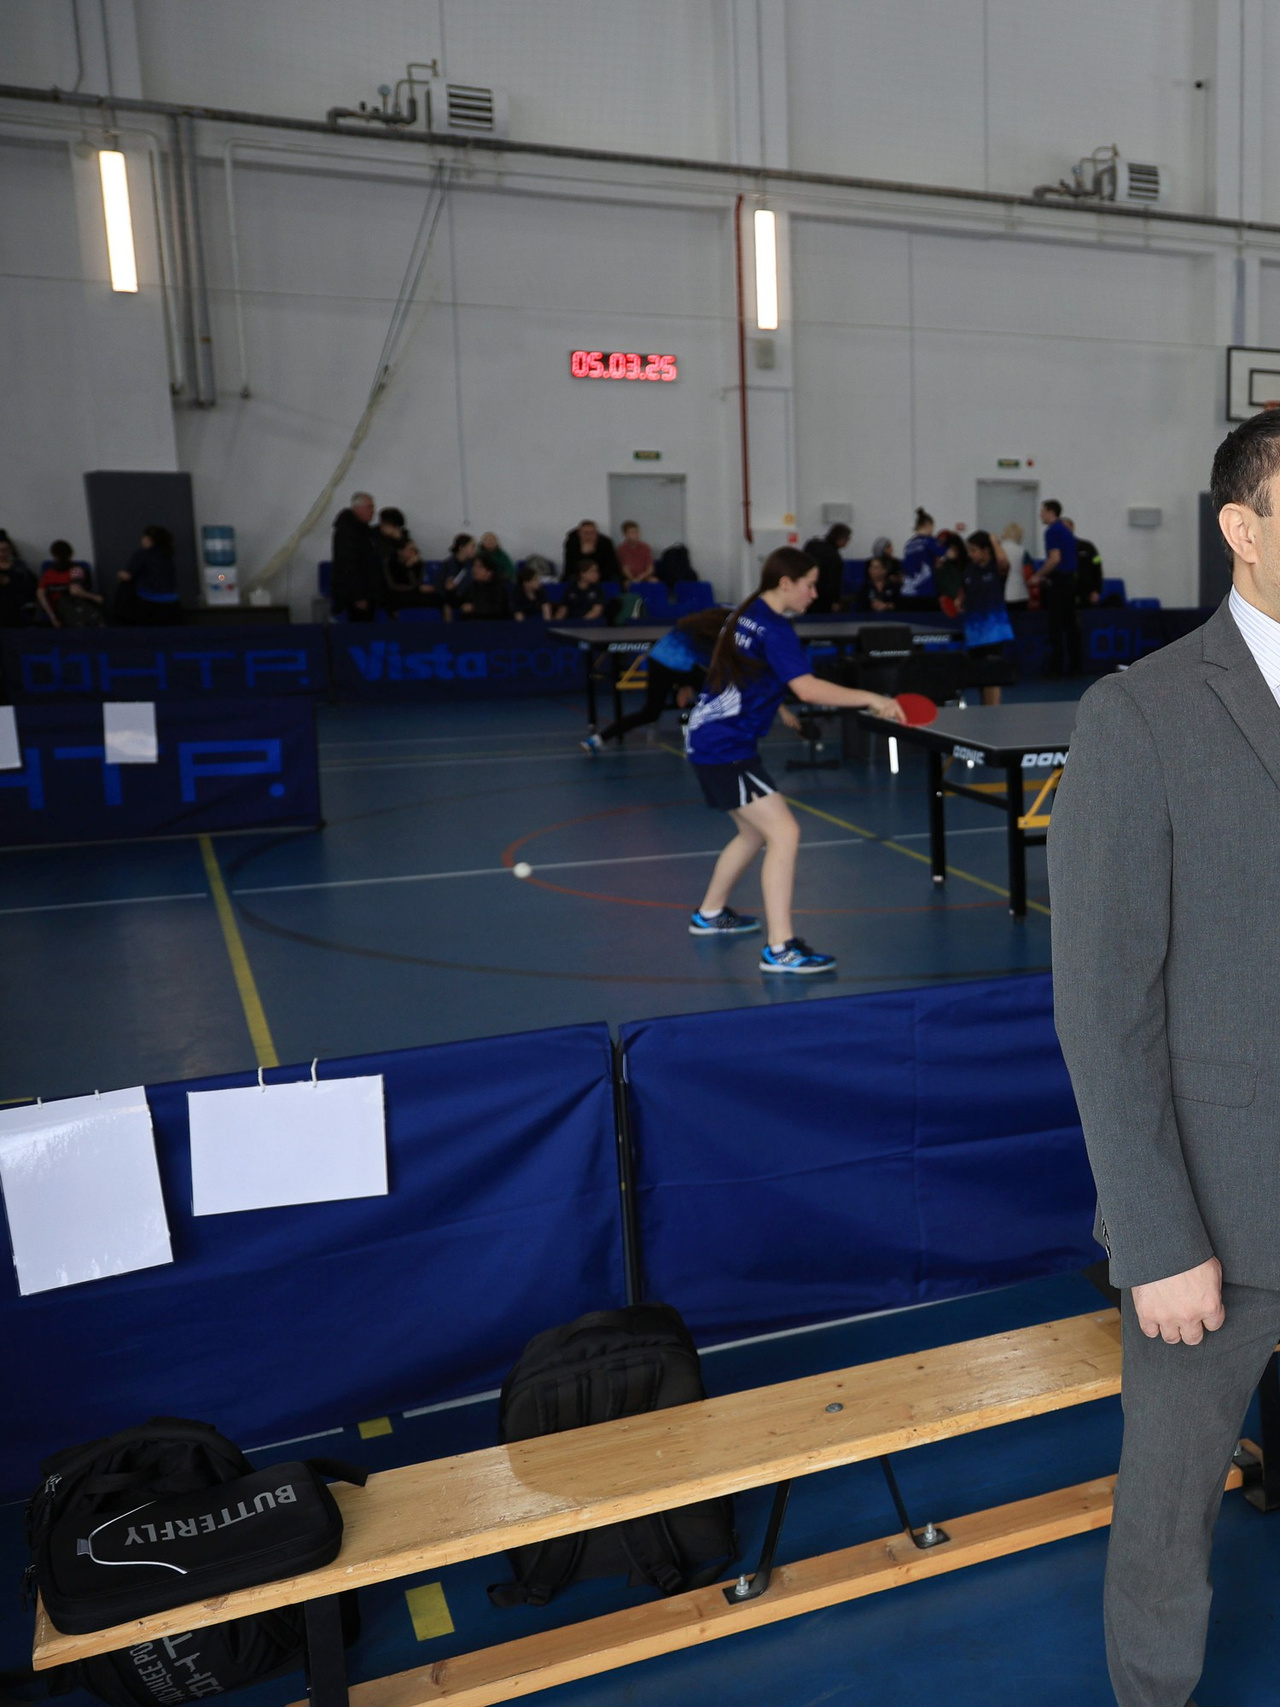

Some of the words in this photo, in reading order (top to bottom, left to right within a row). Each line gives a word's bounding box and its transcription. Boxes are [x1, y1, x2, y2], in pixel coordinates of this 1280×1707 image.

[571, 350, 678, 382] 05.03.25
[350, 640, 489, 682] Vista
[123, 1484, 298, 1546] BUTTERFLY
